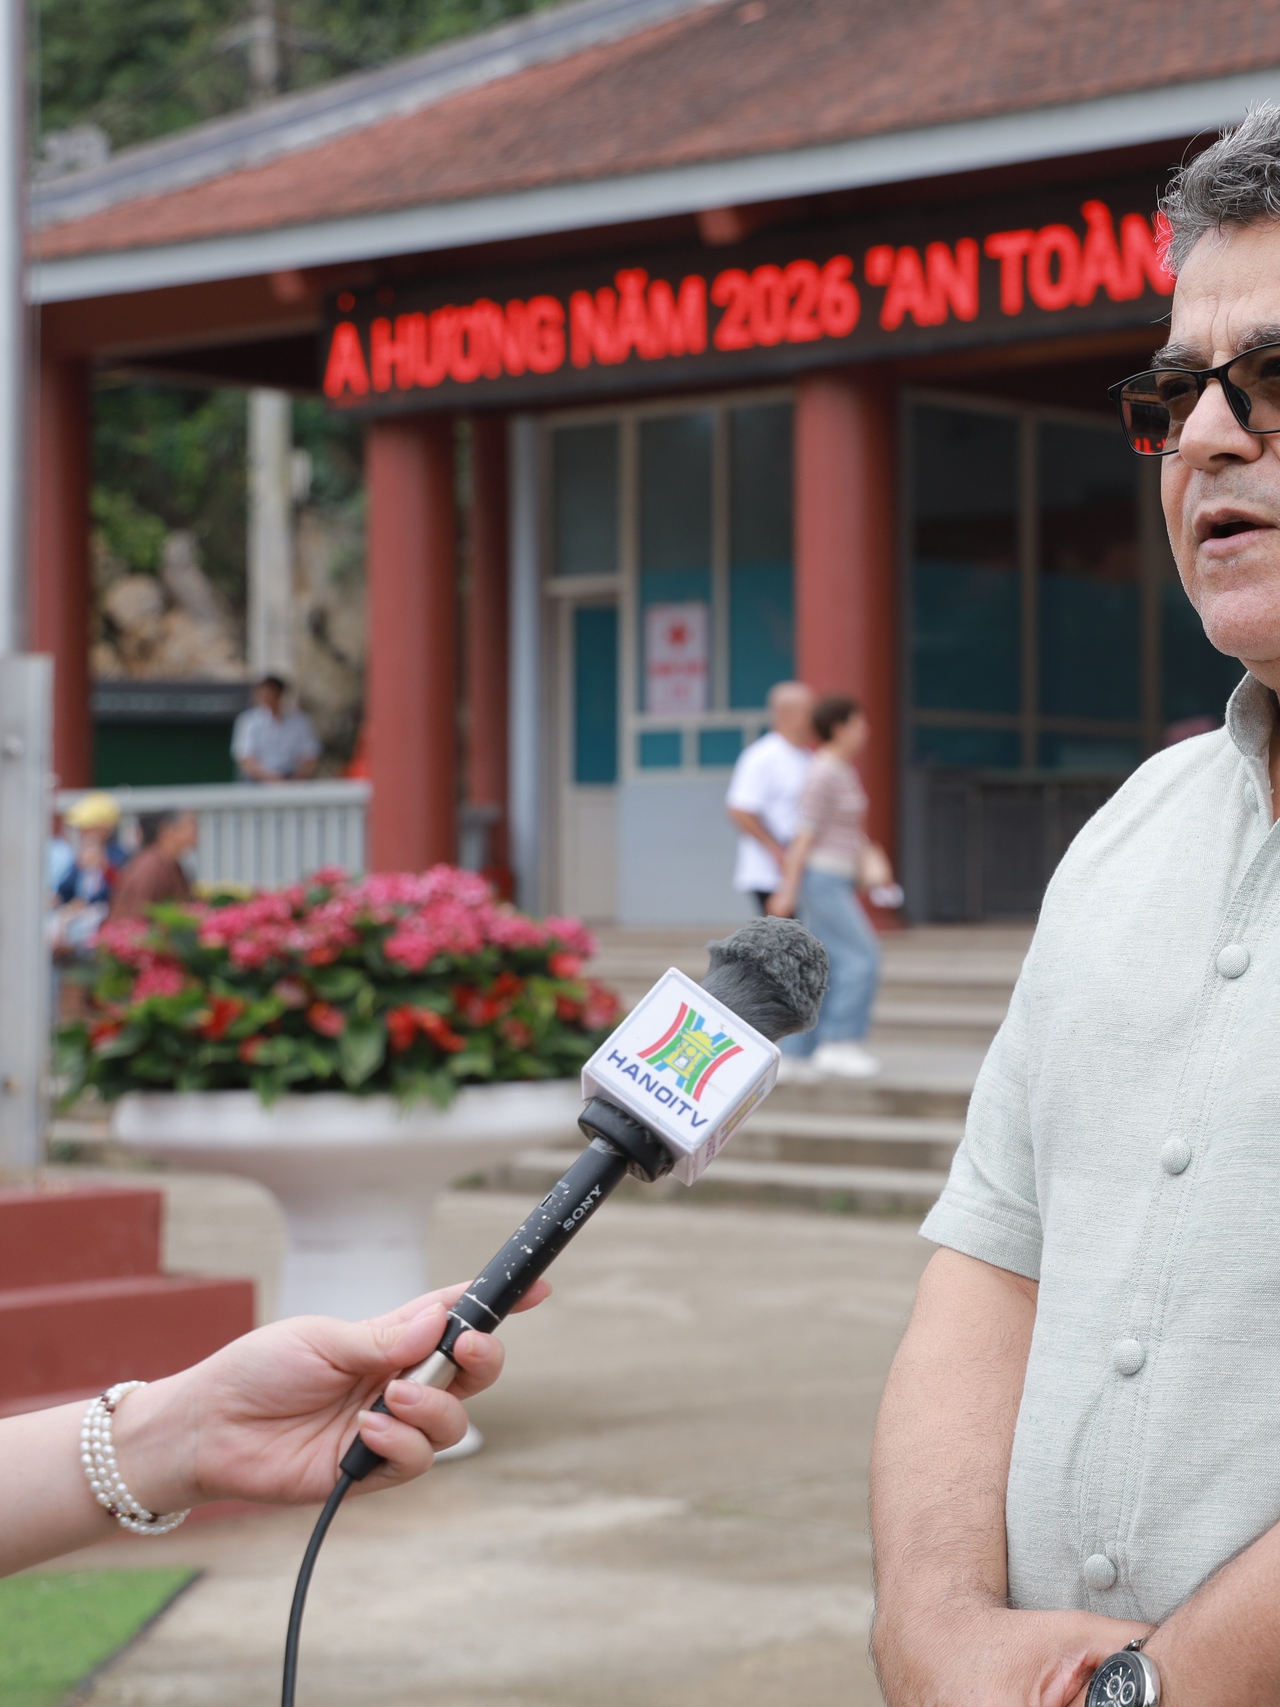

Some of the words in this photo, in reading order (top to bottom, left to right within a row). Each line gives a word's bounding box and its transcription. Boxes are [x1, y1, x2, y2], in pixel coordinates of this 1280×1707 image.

[569, 267, 708, 369] NĂM
[710, 254, 861, 351] 2026
[985, 200, 1176, 316] TOÀN
[607, 1049, 709, 1128] HANOITV
[562, 1184, 602, 1231] SONY
